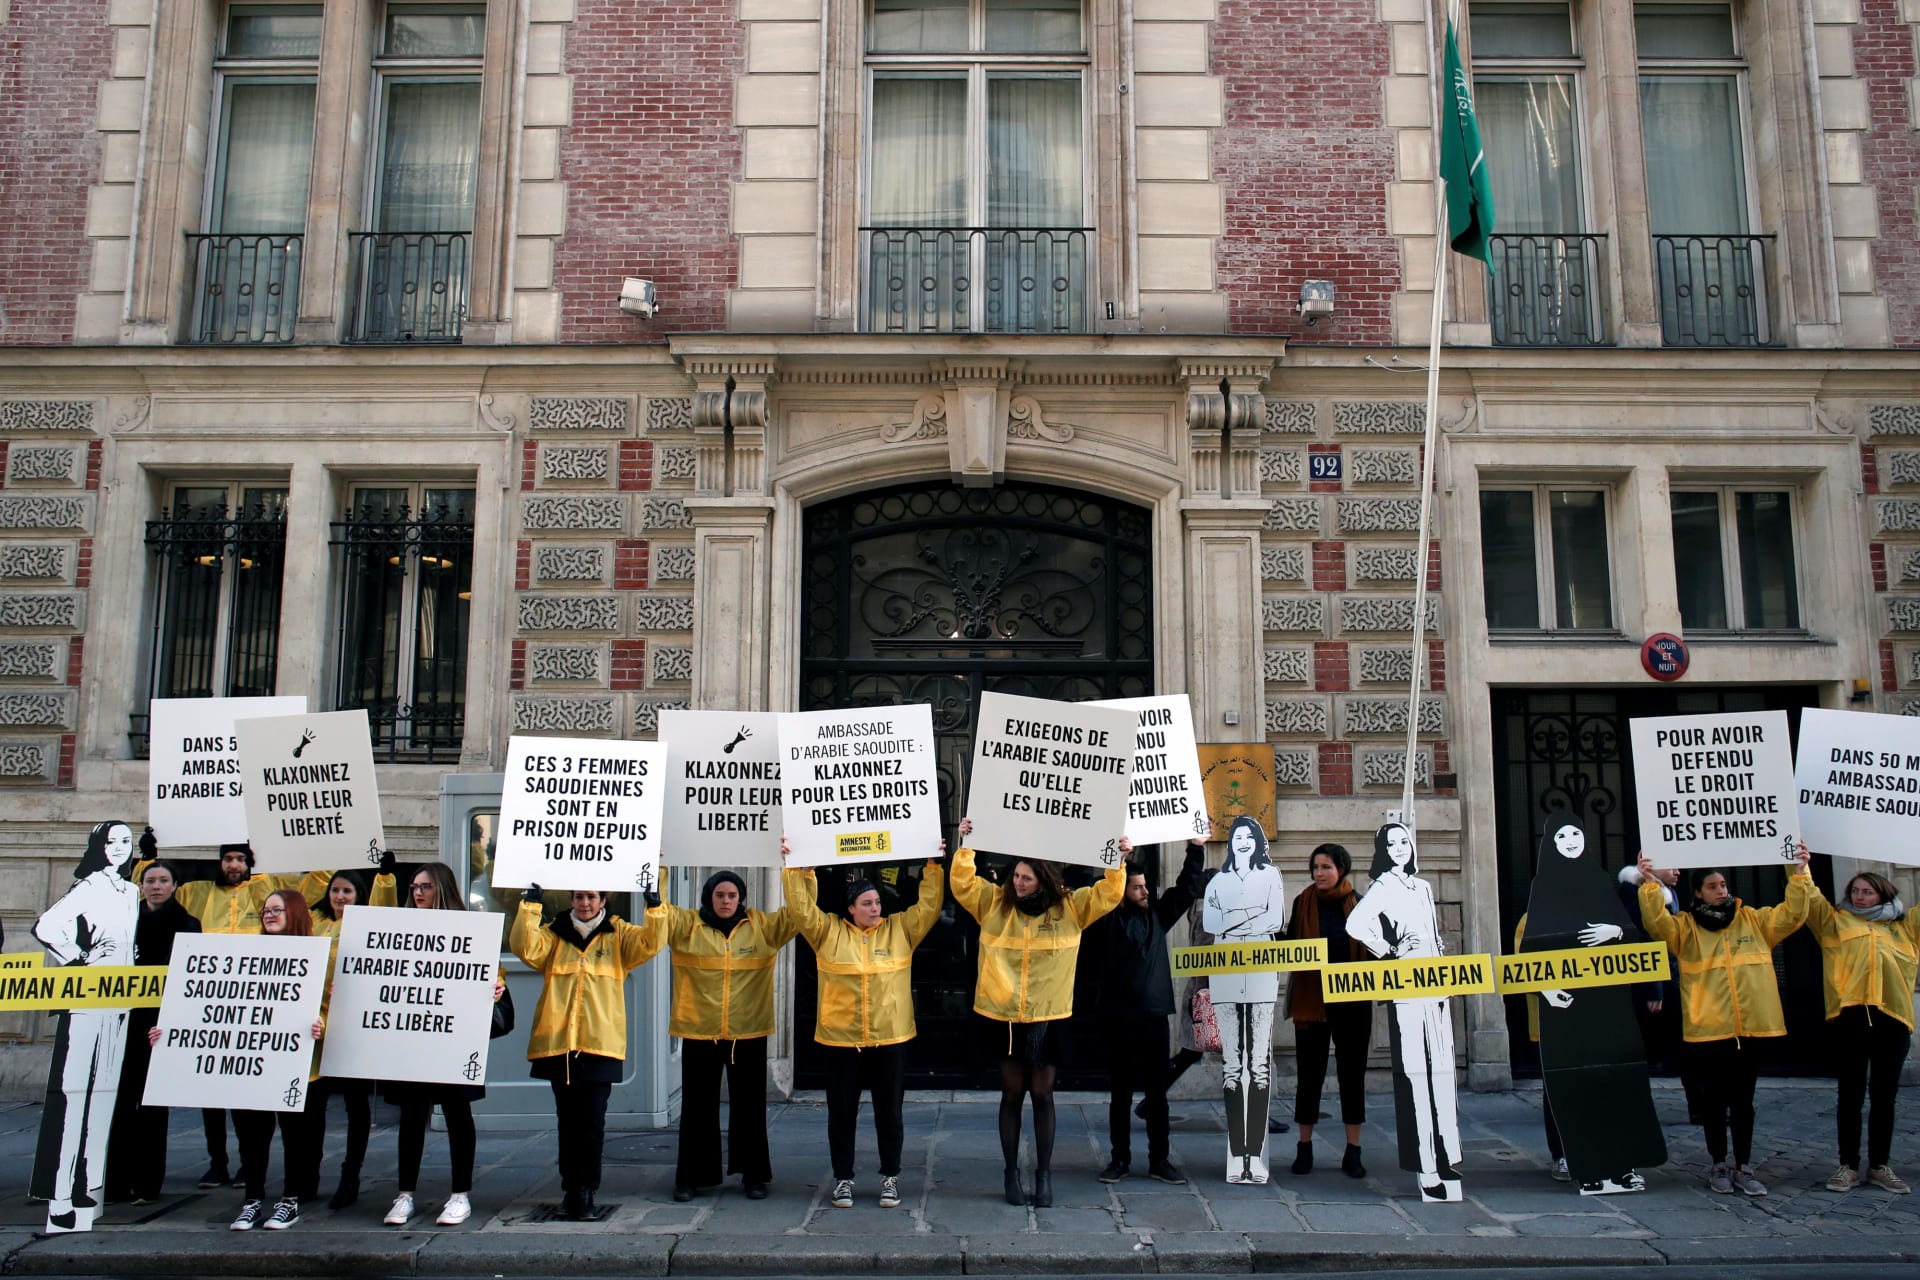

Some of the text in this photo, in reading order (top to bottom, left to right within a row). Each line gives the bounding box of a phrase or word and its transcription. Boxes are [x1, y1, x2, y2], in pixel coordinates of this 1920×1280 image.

[1313, 458, 1337, 475] 92
[1656, 641, 1677, 650] JOUR
[1662, 652, 1672, 661] ET
[1658, 663, 1677, 672] NUIT
[1137, 708, 1173, 728] VOIR
[817, 721, 894, 739] AMBASSADE
[1005, 718, 1109, 748] EXIGEONS DE
[1136, 731, 1166, 750] NDU
[1656, 725, 1764, 748] POUR AVOIR
[183, 736, 224, 753] DANS
[791, 743, 850, 761] D'ARABIE
[853, 738, 915, 756] SAOUDITE
[524, 755, 649, 777] CES 3 FEMMES
[981, 740, 1126, 775] L'ARABIE SAOUDITE
[1131, 753, 1167, 773] ROIT
[1671, 749, 1754, 771] DEFENDU
[1830, 747, 1874, 767] DANS
[1879, 752, 1901, 769] 50
[263, 762, 351, 786] KLAXONNEZ
[685, 760, 782, 781] KLAXONNEZ
[814, 759, 903, 781] KLAXONNEZ
[1827, 769, 1920, 794] AMBASSAD
[157, 781, 225, 800] D'ARABIE
[524, 776, 644, 798] SAOUDIENNES
[791, 779, 929, 805] POUR LES DROITS
[1019, 770, 1083, 794] QU'ELLE
[1128, 773, 1189, 797] NDUIRE
[1674, 772, 1755, 794] LE DROIT
[267, 789, 353, 812] POUR LEUR
[685, 786, 783, 806] POUR LEUR
[1003, 792, 1093, 821] LES LIBÈRE
[1656, 795, 1779, 819] DE CONDUIRE
[1799, 788, 1920, 818] D'ARABIE SAOU
[546, 798, 618, 818] SONT EN
[811, 802, 912, 826] DES FEMMES
[1128, 796, 1189, 820] FEMMES
[281, 811, 345, 837] LIBERTÉ
[512, 819, 647, 841] PRISON DEPUIS
[698, 809, 769, 832] LIBERTÉ
[1662, 819, 1778, 842] DES FEMMES
[544, 842, 614, 862] 10 MOIS
[840, 836, 871, 846] AMNESTY
[366, 931, 473, 954] EXIGEONS DE
[186, 954, 309, 978] CES 3 FEMMES
[341, 956, 491, 982] L'ARABIE SAOUDITE
[1175, 946, 1321, 970] LOUJAIN AL-HATHLOUL
[1502, 950, 1661, 985] AZIZA AL-YOUSEF
[0, 977, 56, 1000] IMAN
[1327, 962, 1484, 994] IMAN AL-NAFJAN
[183, 979, 302, 1002] SAOUDIENNES
[379, 984, 445, 1006] QU'ELLE
[201, 1004, 274, 1026] SONT EN
[362, 1010, 455, 1034] LES LIBÈRE
[167, 1028, 301, 1053] PRISON DEPUIS
[196, 1054, 265, 1077] 10 MOIS
